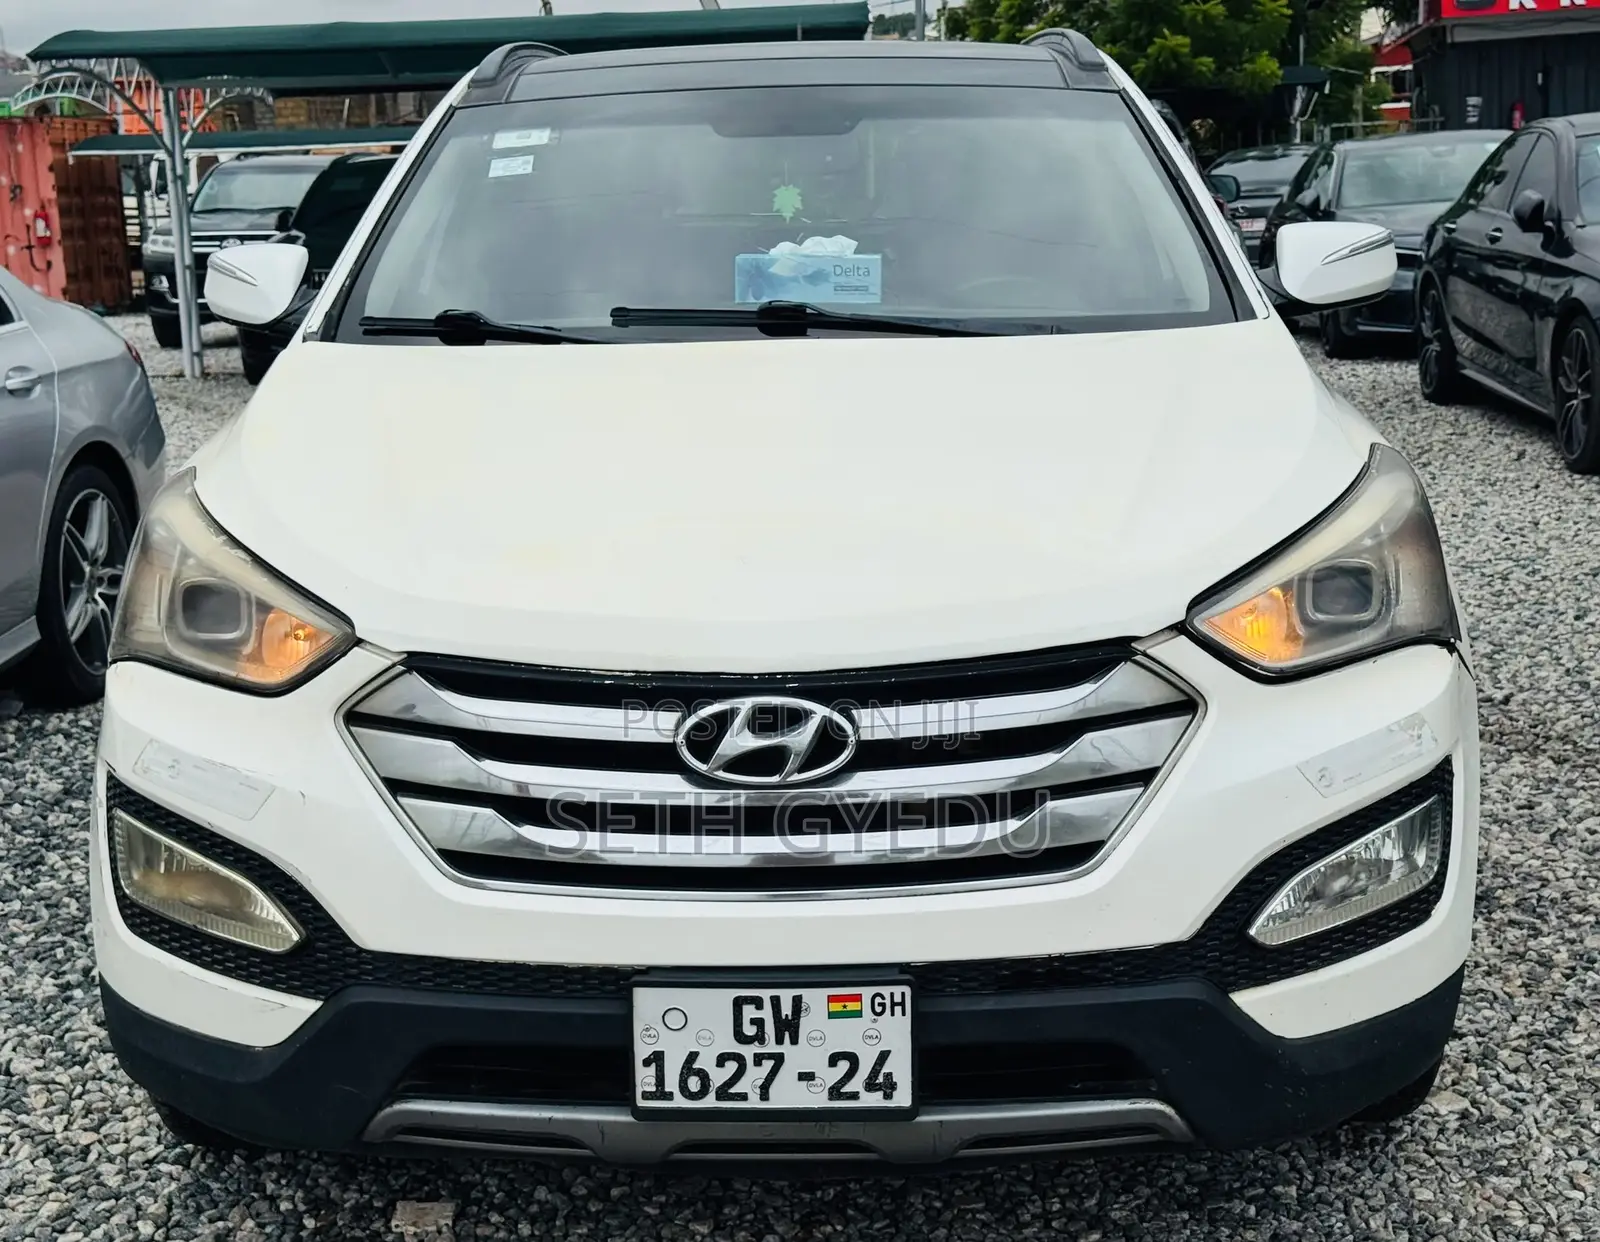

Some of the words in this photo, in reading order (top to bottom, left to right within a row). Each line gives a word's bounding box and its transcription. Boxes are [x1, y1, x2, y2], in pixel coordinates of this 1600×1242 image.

[833, 264, 871, 277] Delta
[732, 993, 803, 1046] GW
[870, 991, 906, 1017] GH
[641, 1050, 897, 1101] 1627-24
